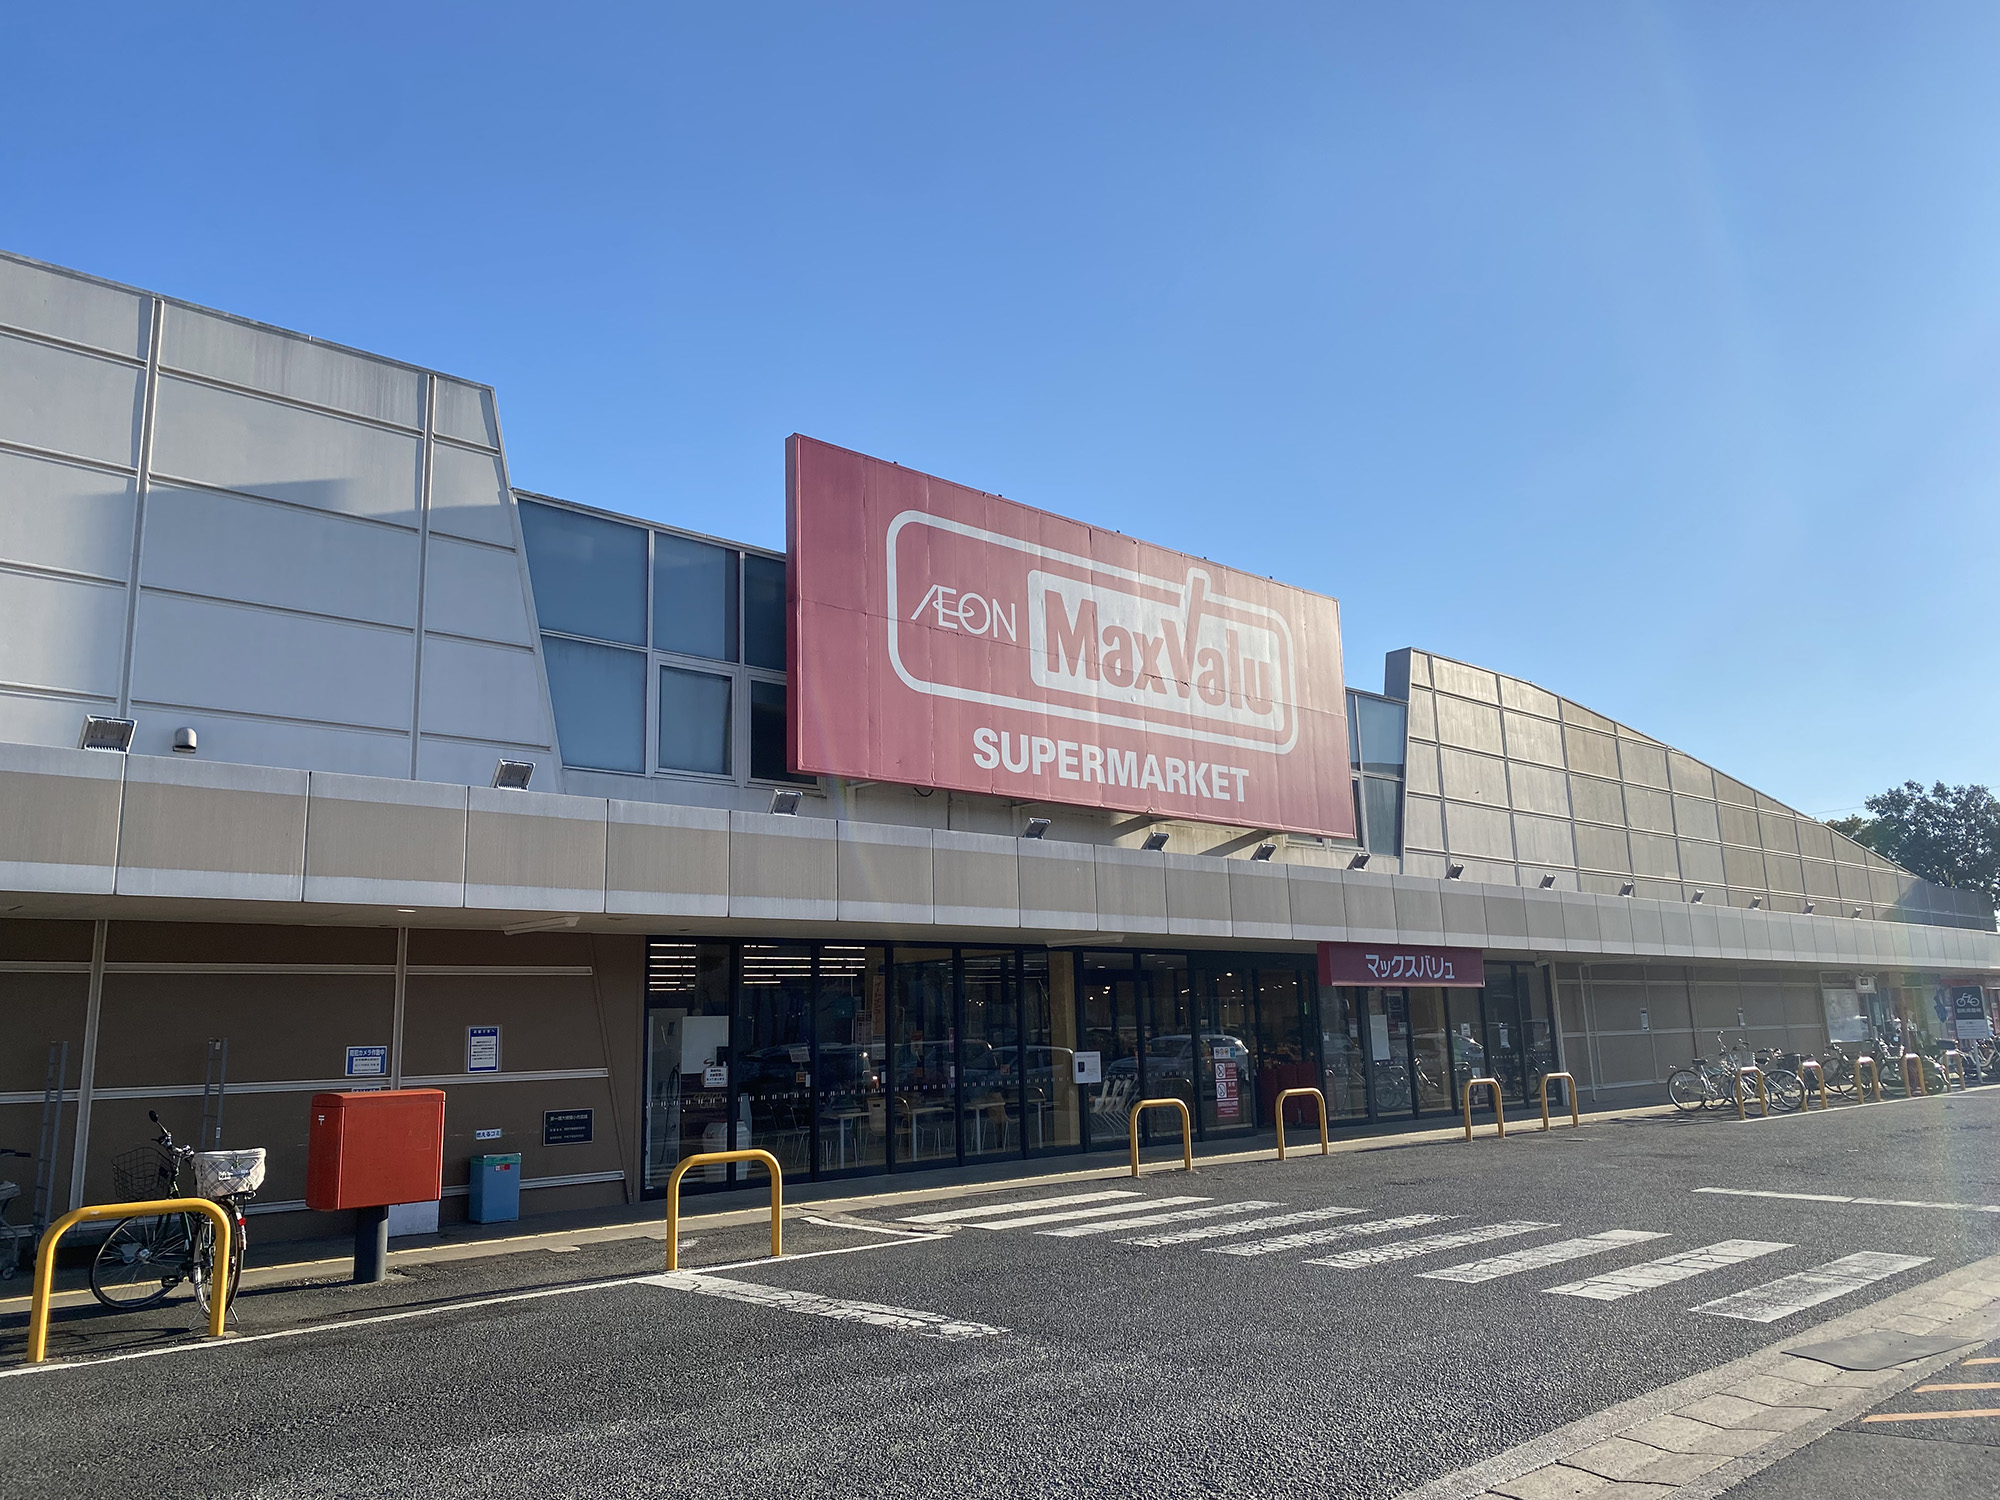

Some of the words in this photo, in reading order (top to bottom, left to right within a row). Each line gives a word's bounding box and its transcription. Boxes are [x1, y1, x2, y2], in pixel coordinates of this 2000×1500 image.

[1044, 577, 1274, 716] MaxValu
[973, 727, 1250, 803] SUPERMARKET
[1365, 954, 1456, 980] マックスバリュ
